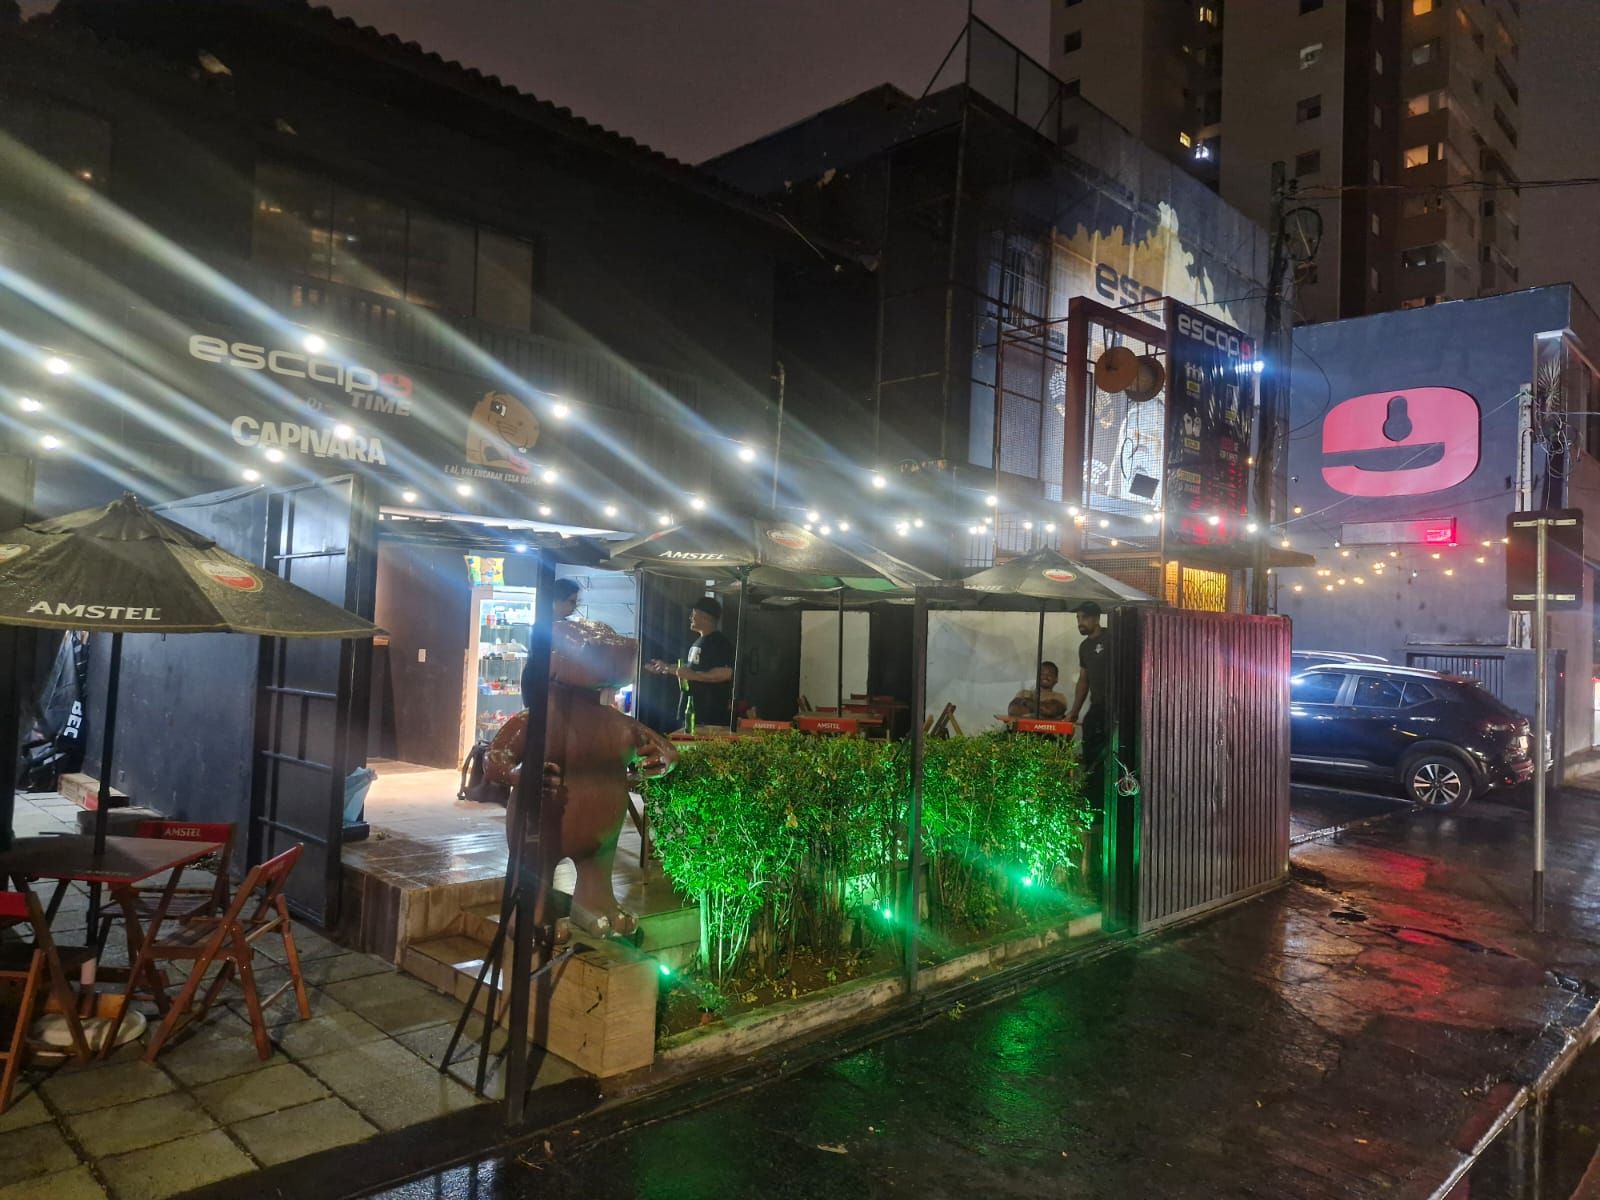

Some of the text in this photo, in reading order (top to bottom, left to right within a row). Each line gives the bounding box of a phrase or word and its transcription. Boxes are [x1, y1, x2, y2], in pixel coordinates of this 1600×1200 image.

[350, 390, 410, 417] TIME
[231, 415, 387, 466] CAPIVARA
[658, 550, 727, 560] AMSTEL
[28, 601, 161, 621] AMSTEL
